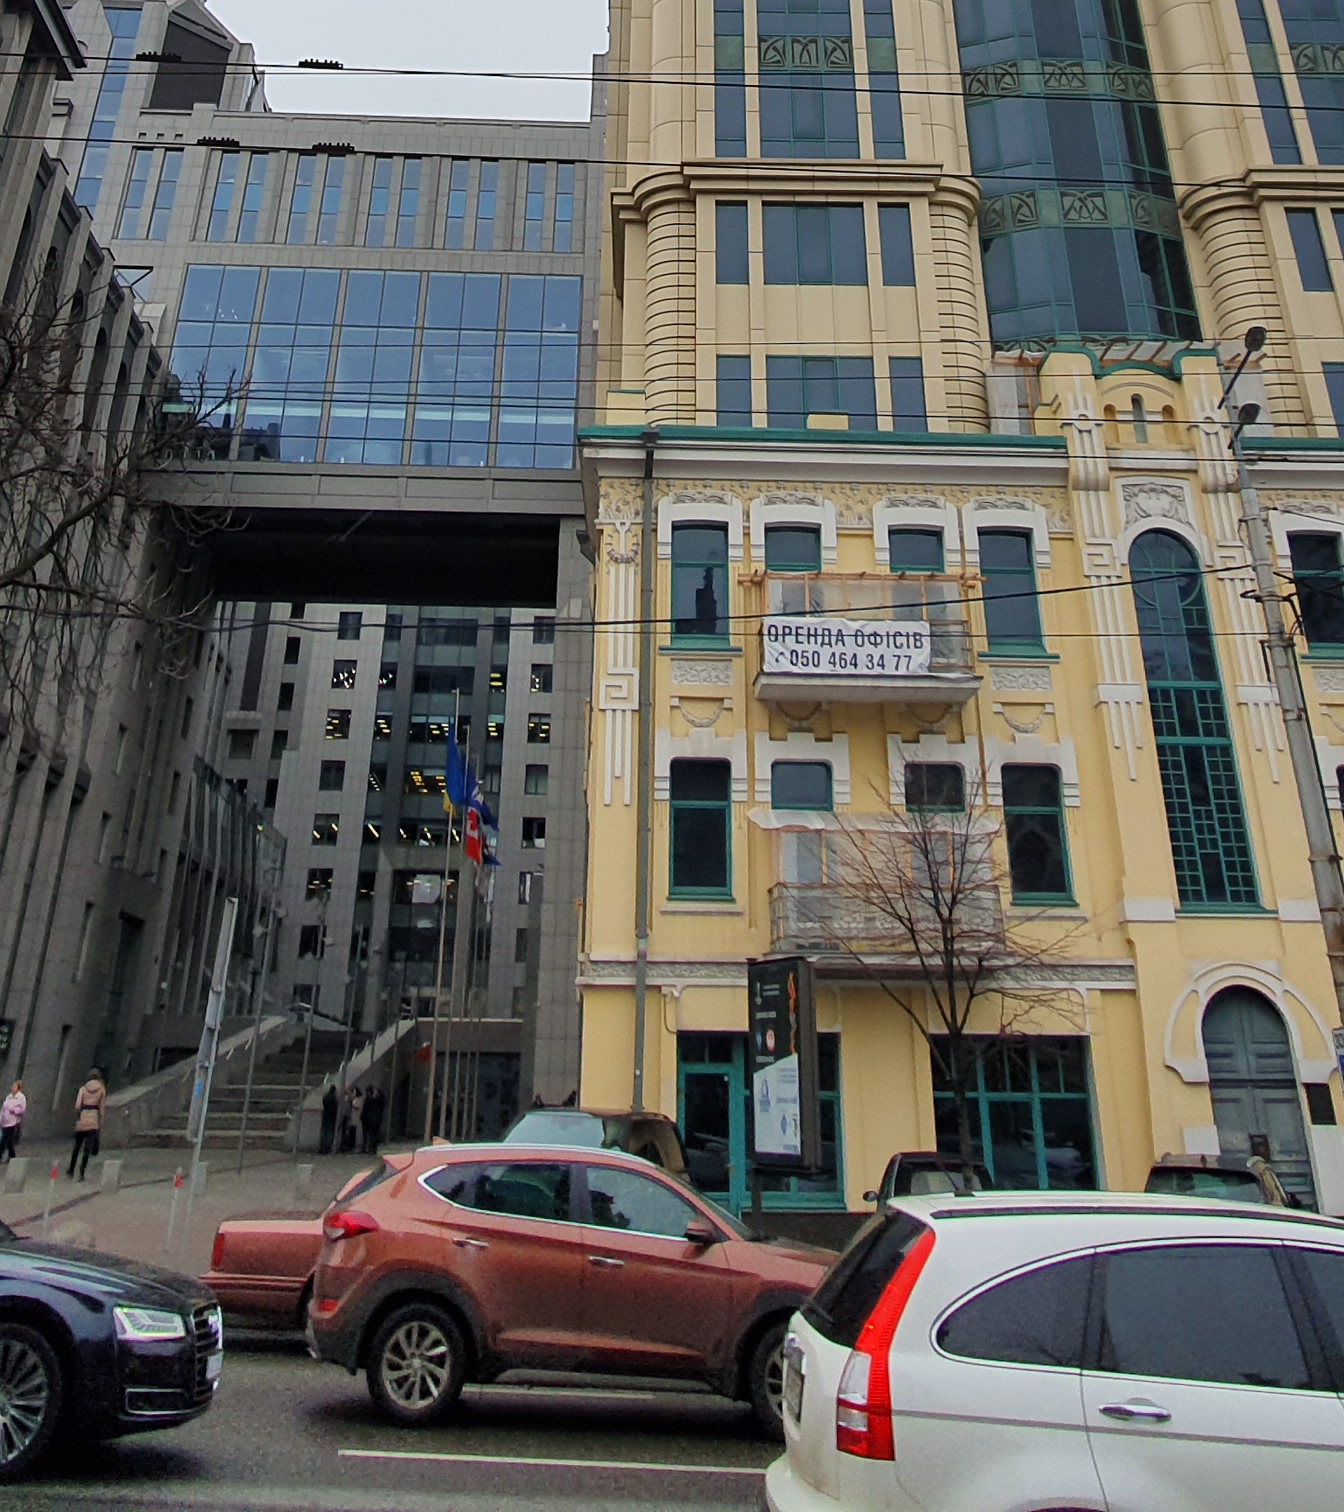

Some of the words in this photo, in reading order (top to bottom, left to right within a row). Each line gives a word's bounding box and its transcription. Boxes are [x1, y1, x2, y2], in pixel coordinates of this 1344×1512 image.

[767, 623, 846, 648] ОРЕНДА
[854, 628, 924, 650] ОФІСІВ
[789, 649, 821, 668] 050
[828, 650, 859, 670] 464
[865, 653, 886, 671] 34
[892, 654, 912, 672] 77
